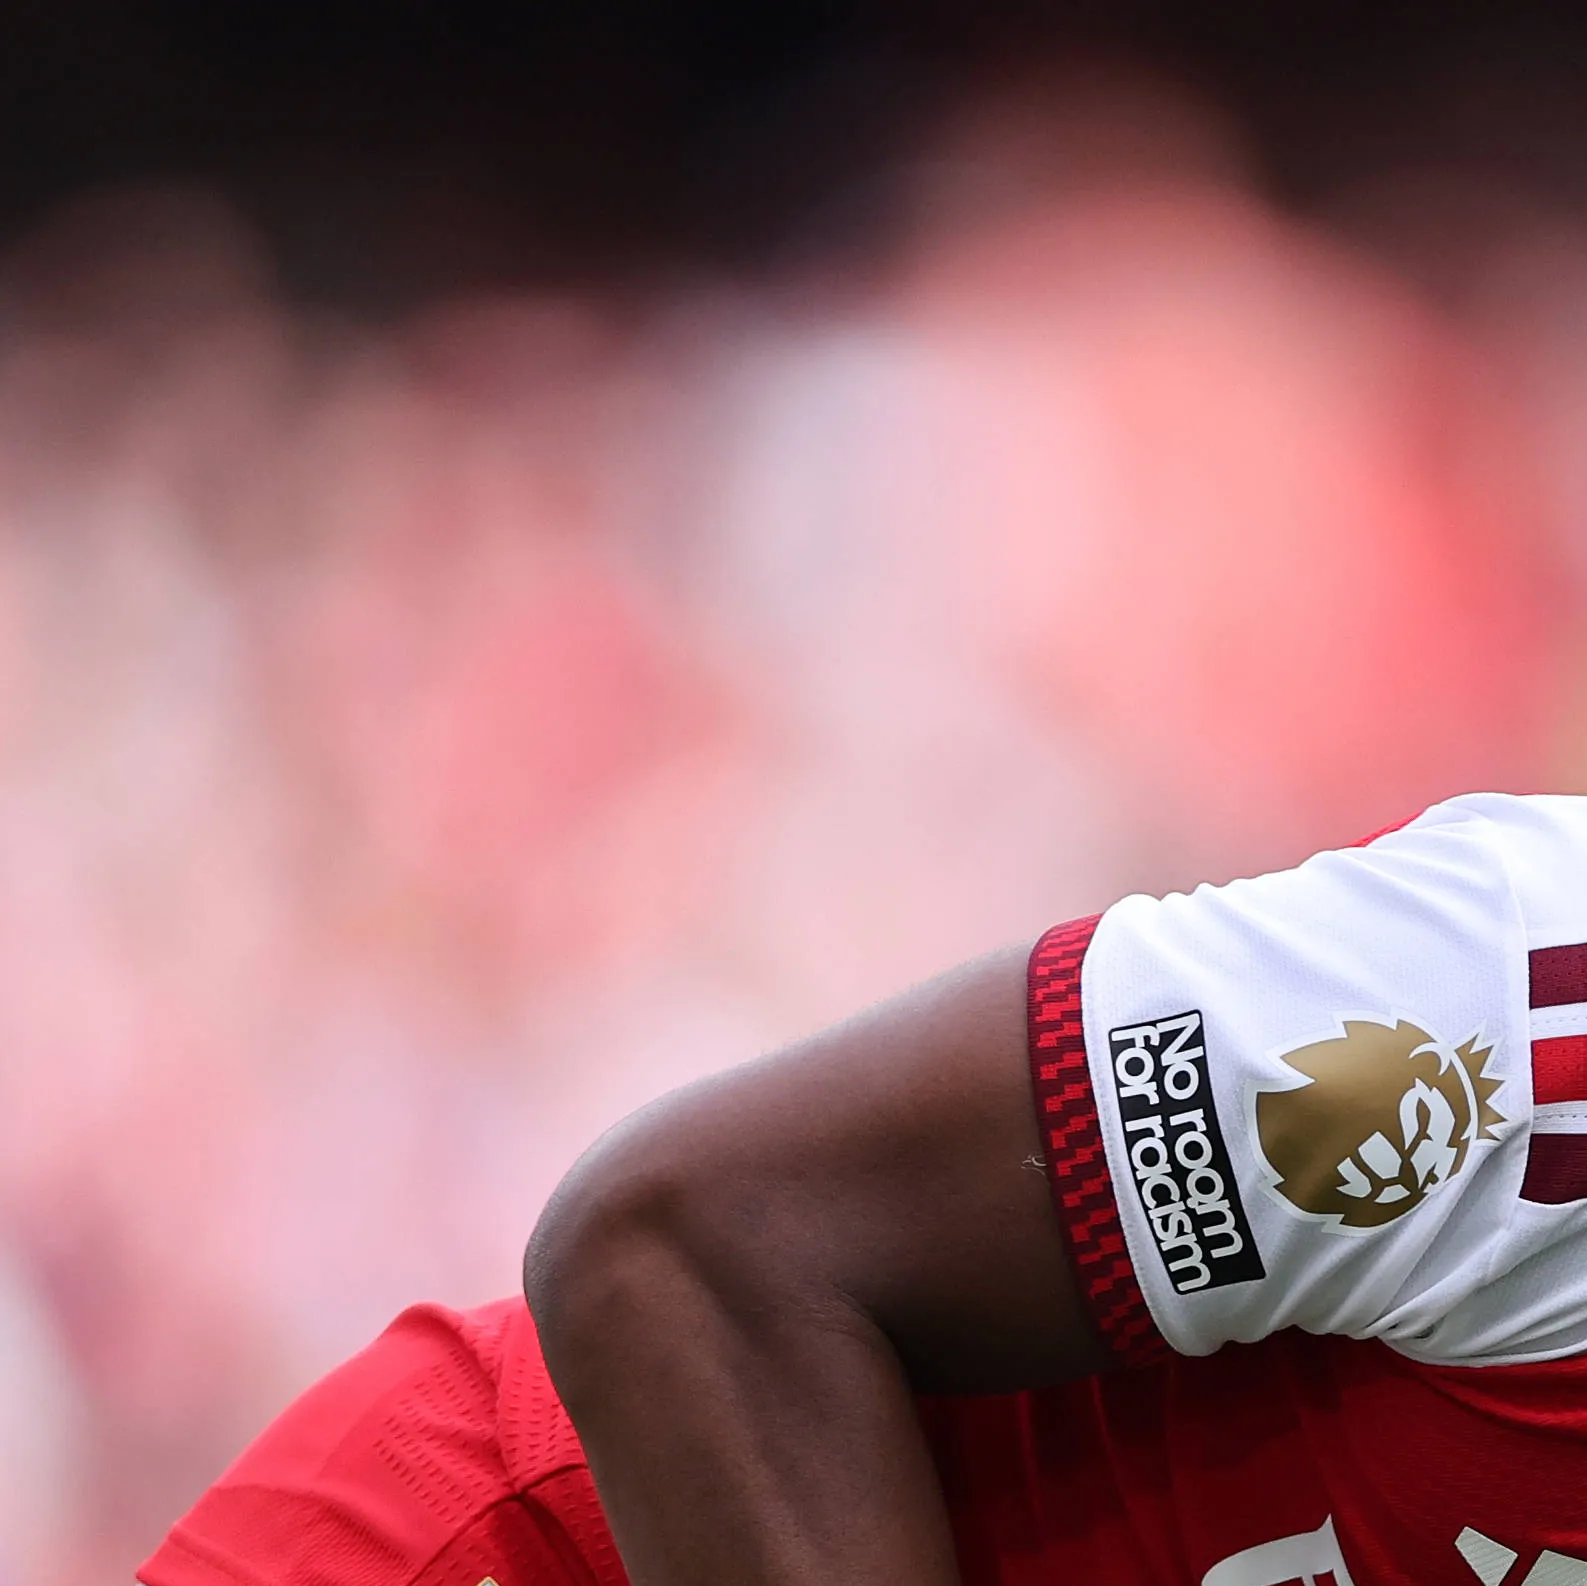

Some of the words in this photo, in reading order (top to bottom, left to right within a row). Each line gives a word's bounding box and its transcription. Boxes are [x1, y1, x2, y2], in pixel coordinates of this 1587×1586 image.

[1110, 1027, 1160, 1108] for
[1156, 1014, 1202, 1101] No
[1125, 1114, 1212, 1292] racism
[1169, 1109, 1244, 1260] room
